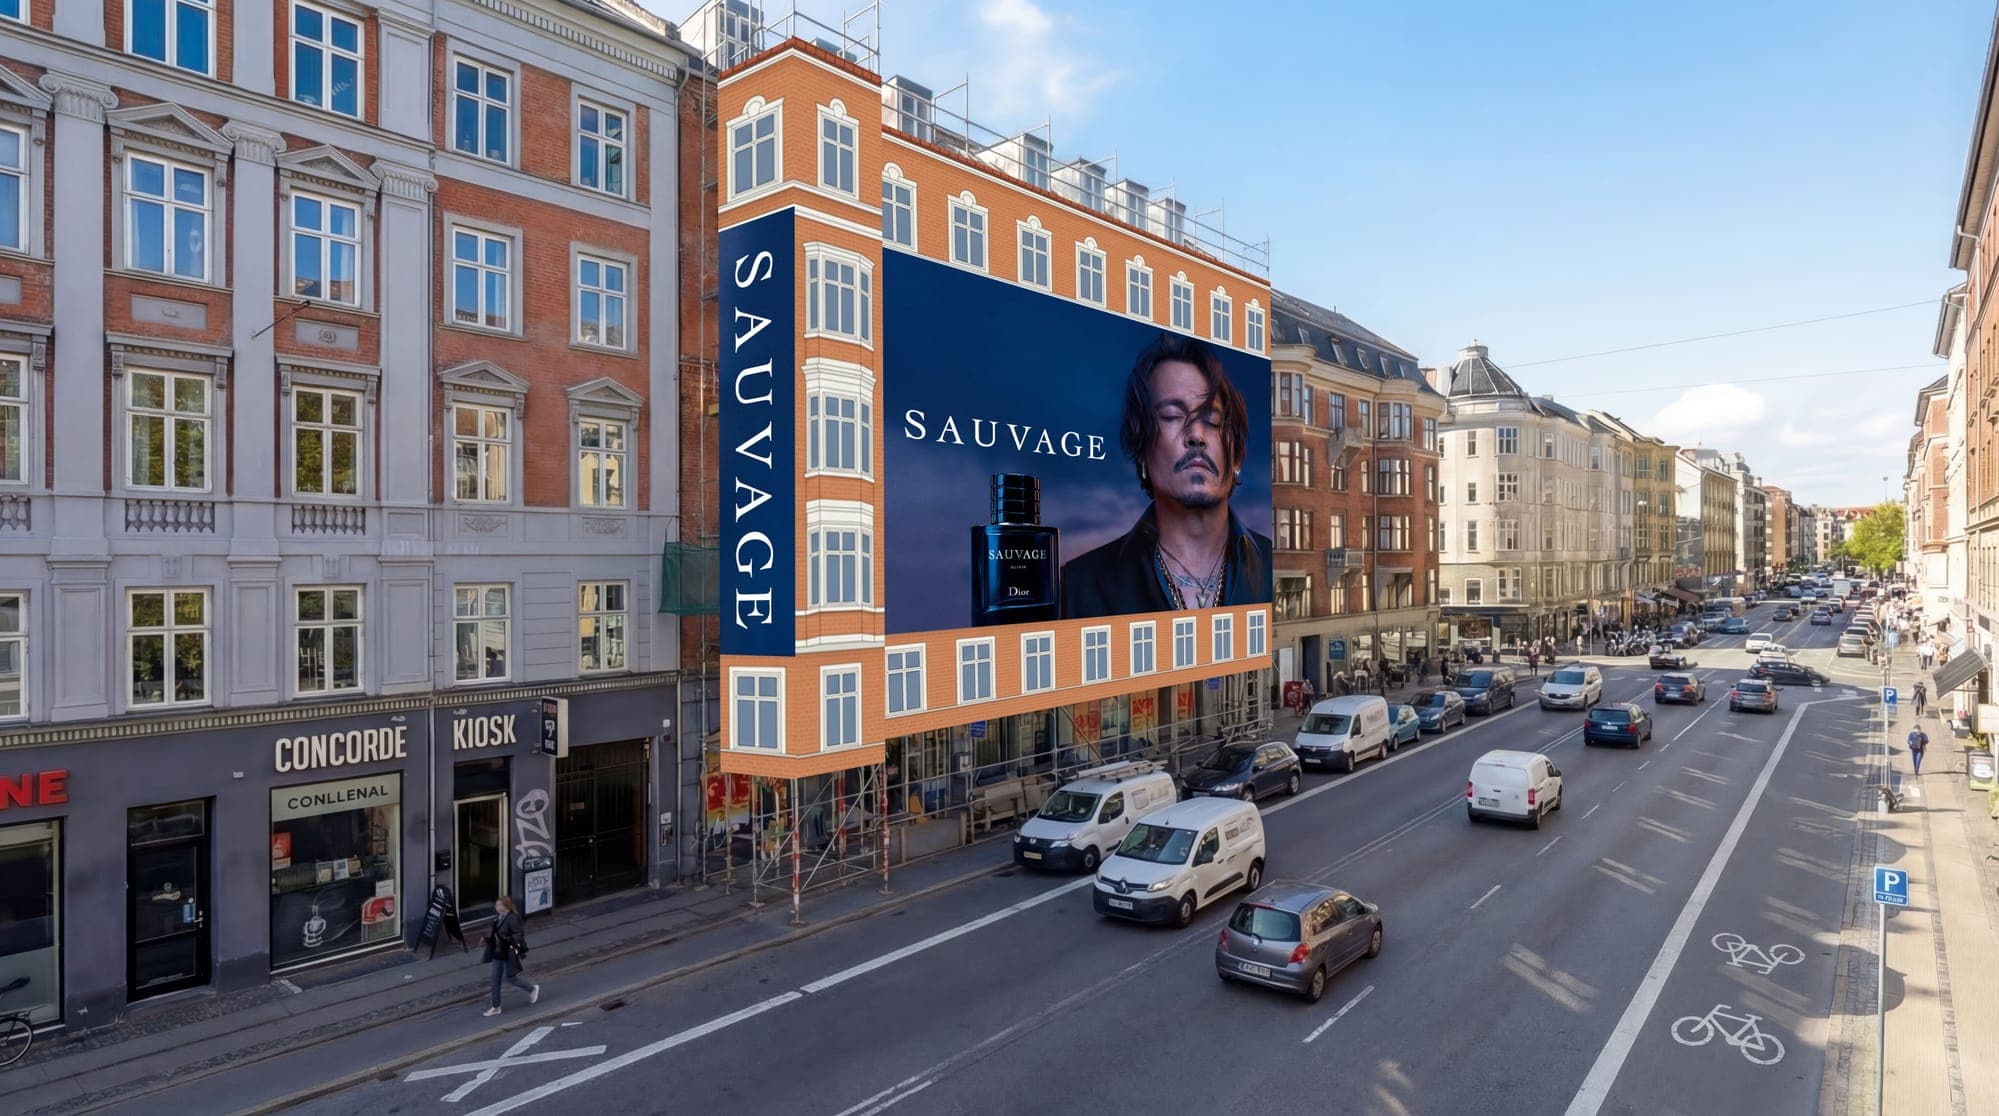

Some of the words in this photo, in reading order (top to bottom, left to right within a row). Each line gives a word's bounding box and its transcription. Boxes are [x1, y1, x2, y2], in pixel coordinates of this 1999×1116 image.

[734, 250, 775, 630] SAUVAGE
[904, 409, 1107, 460] SAUVAGE
[988, 549, 1047, 560] SAUVAGE
[1008, 586, 1030, 597] Dior
[1886, 689, 1895, 701] P
[453, 714, 517, 750] KIOSK
[275, 726, 407, 773] CONCORDE
[287, 785, 389, 810] CONLLENAL
[1884, 871, 1900, 892] P
